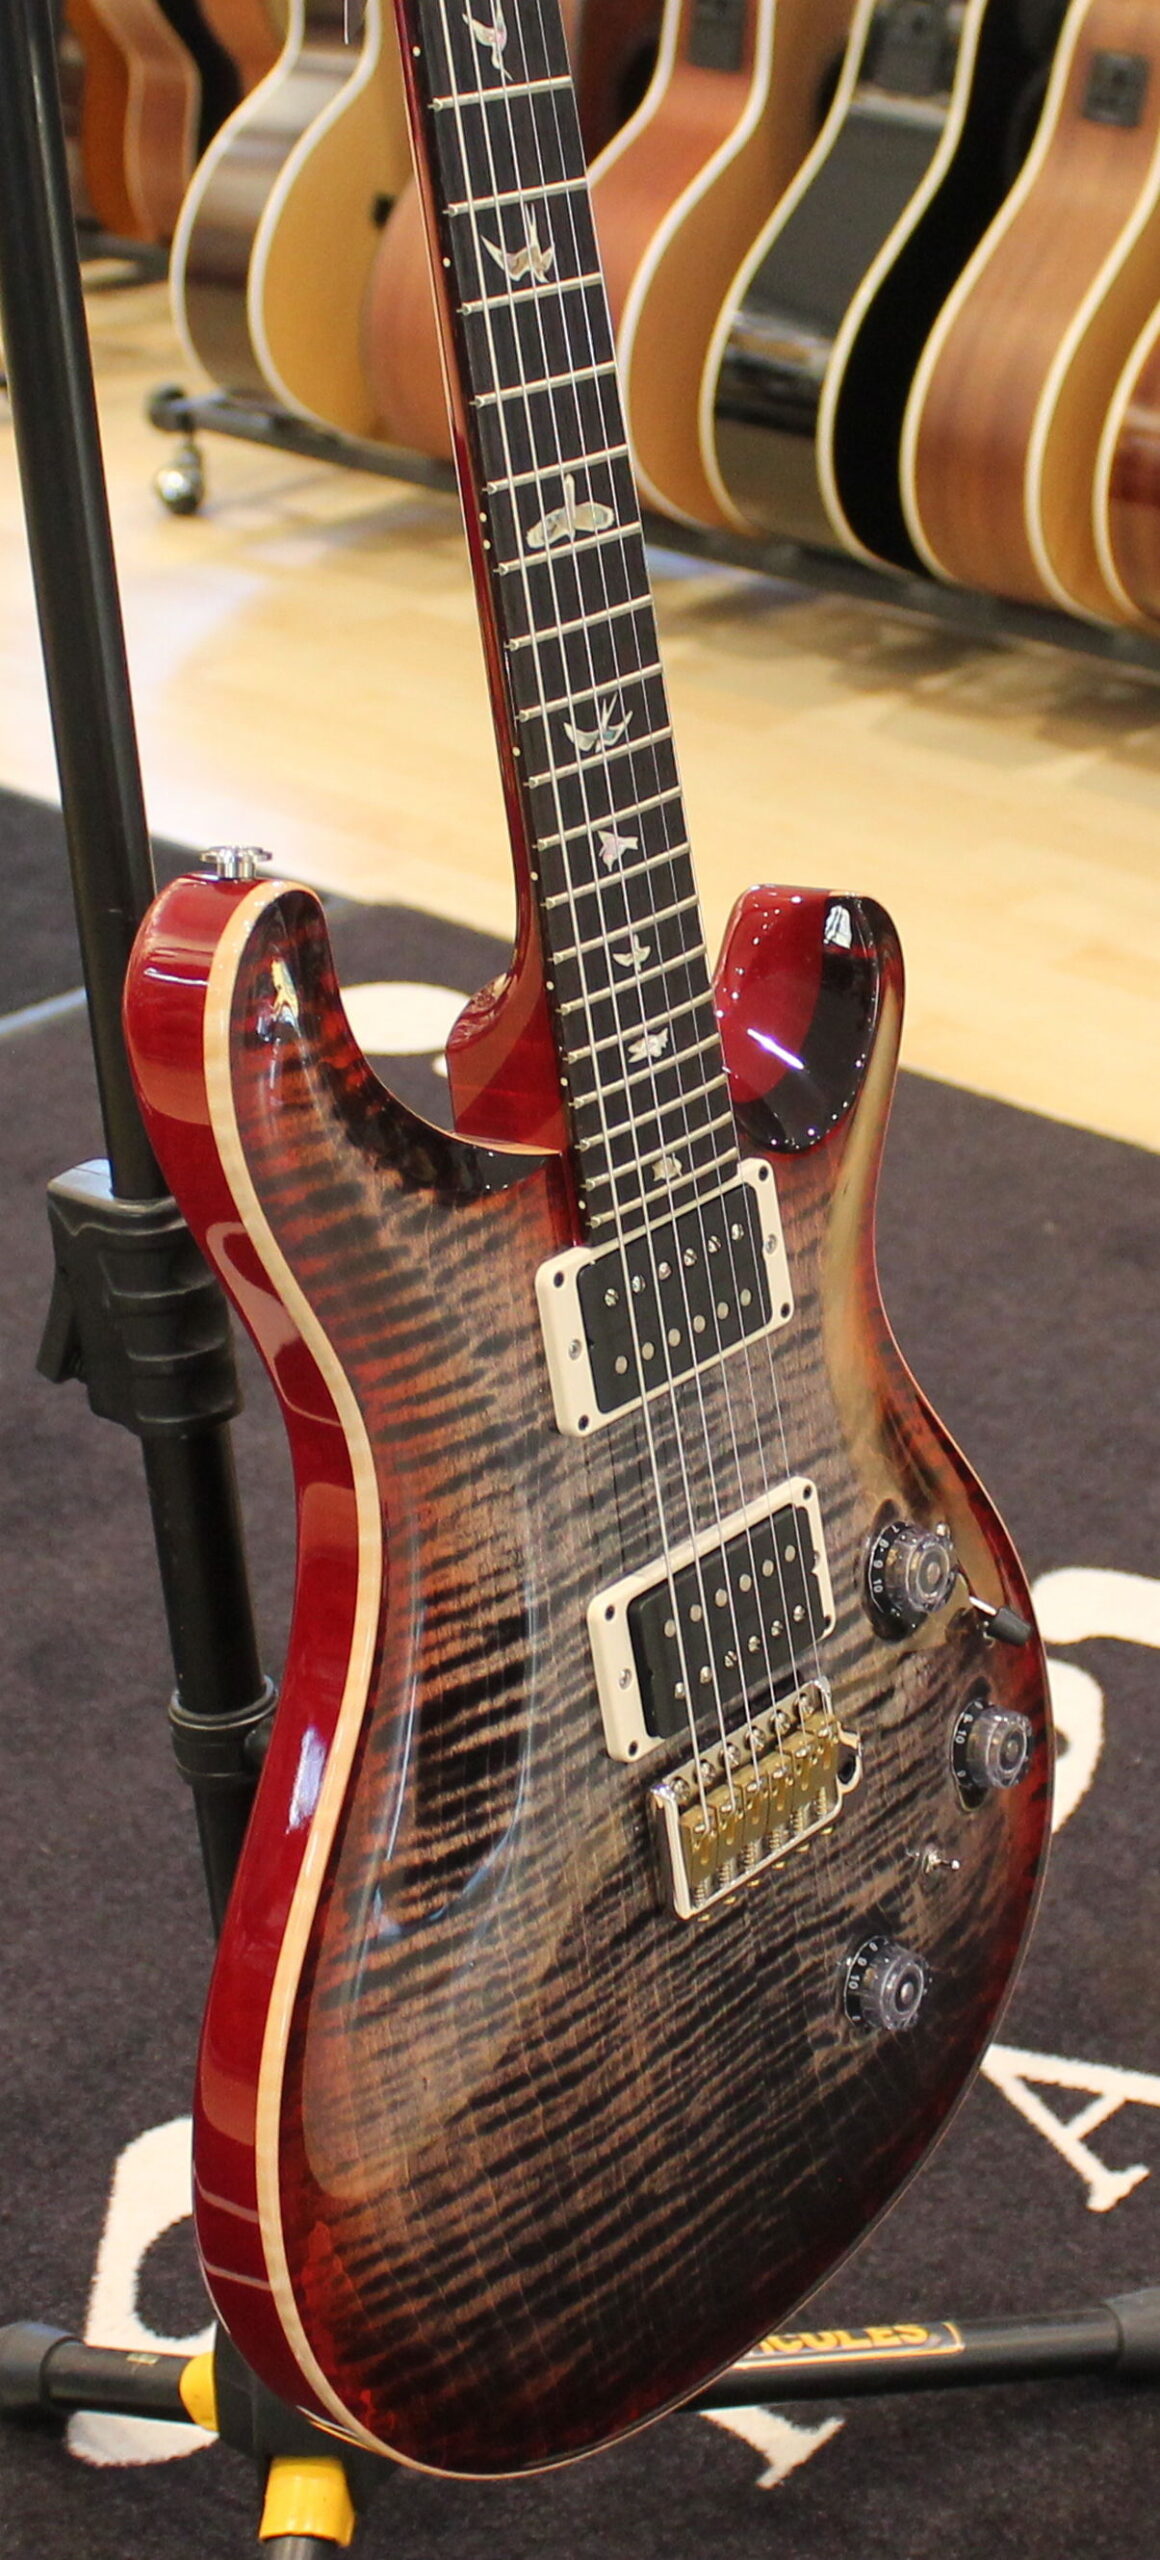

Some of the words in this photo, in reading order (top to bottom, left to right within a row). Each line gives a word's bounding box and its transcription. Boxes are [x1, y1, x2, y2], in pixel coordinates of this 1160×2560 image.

[873, 1559, 884, 1569] 9
[873, 1579, 884, 1593] 10
[955, 1730, 967, 1745] 10
[848, 1974, 860, 1990] 10
